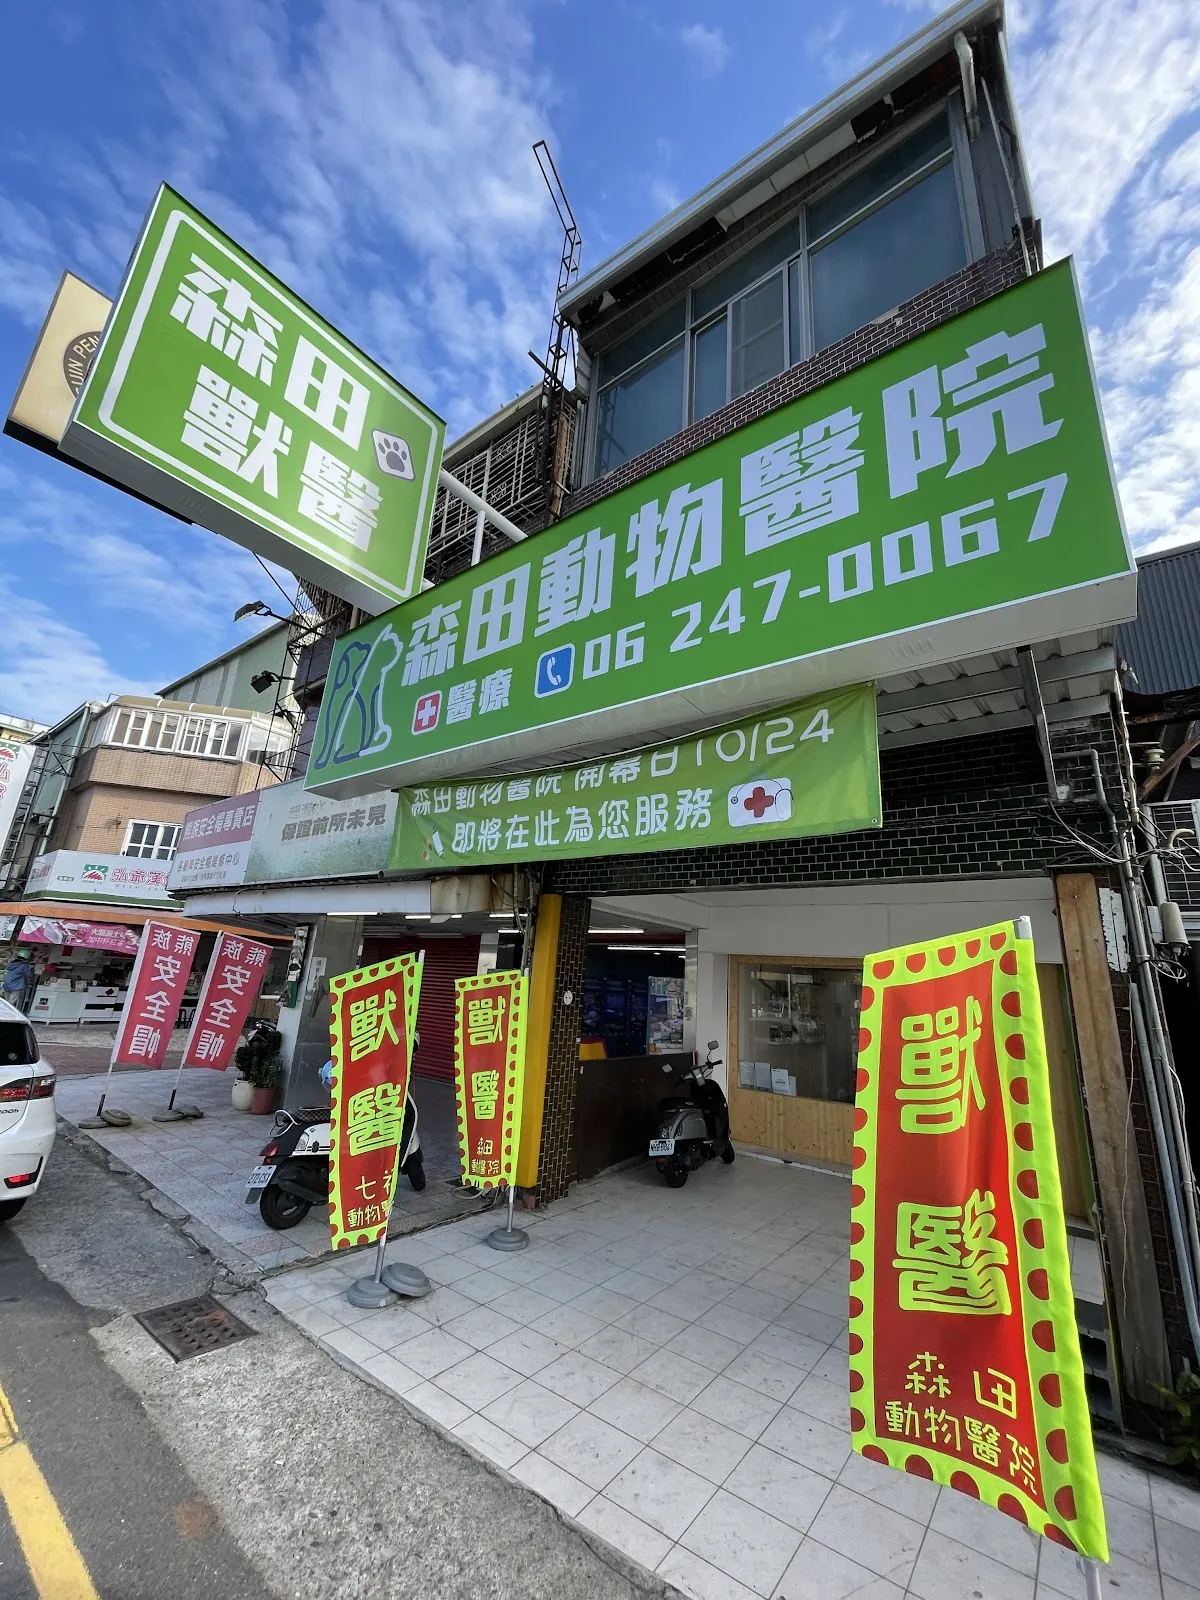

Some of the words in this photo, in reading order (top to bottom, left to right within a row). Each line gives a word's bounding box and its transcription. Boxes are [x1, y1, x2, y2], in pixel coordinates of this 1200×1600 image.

[169, 253, 371, 452] 森田
[181, 364, 384, 552] 獸醫
[401, 321, 1066, 687] 森田動物醫院
[582, 622, 646, 680] 06
[669, 472, 1069, 653] 247-0067
[445, 667, 513, 725] 醫療
[110, 867, 169, 886] 弘爺漢
[281, 803, 387, 841] 保證前所未見
[451, 786, 713, 854] 即將在此為您服務
[346, 988, 405, 1157] 獸醫
[467, 995, 506, 1120] 獸醫
[891, 995, 1014, 1317] 獸醫
[884, 1400, 1038, 1496] 動物醫院
[904, 1351, 1018, 1420] 森田
